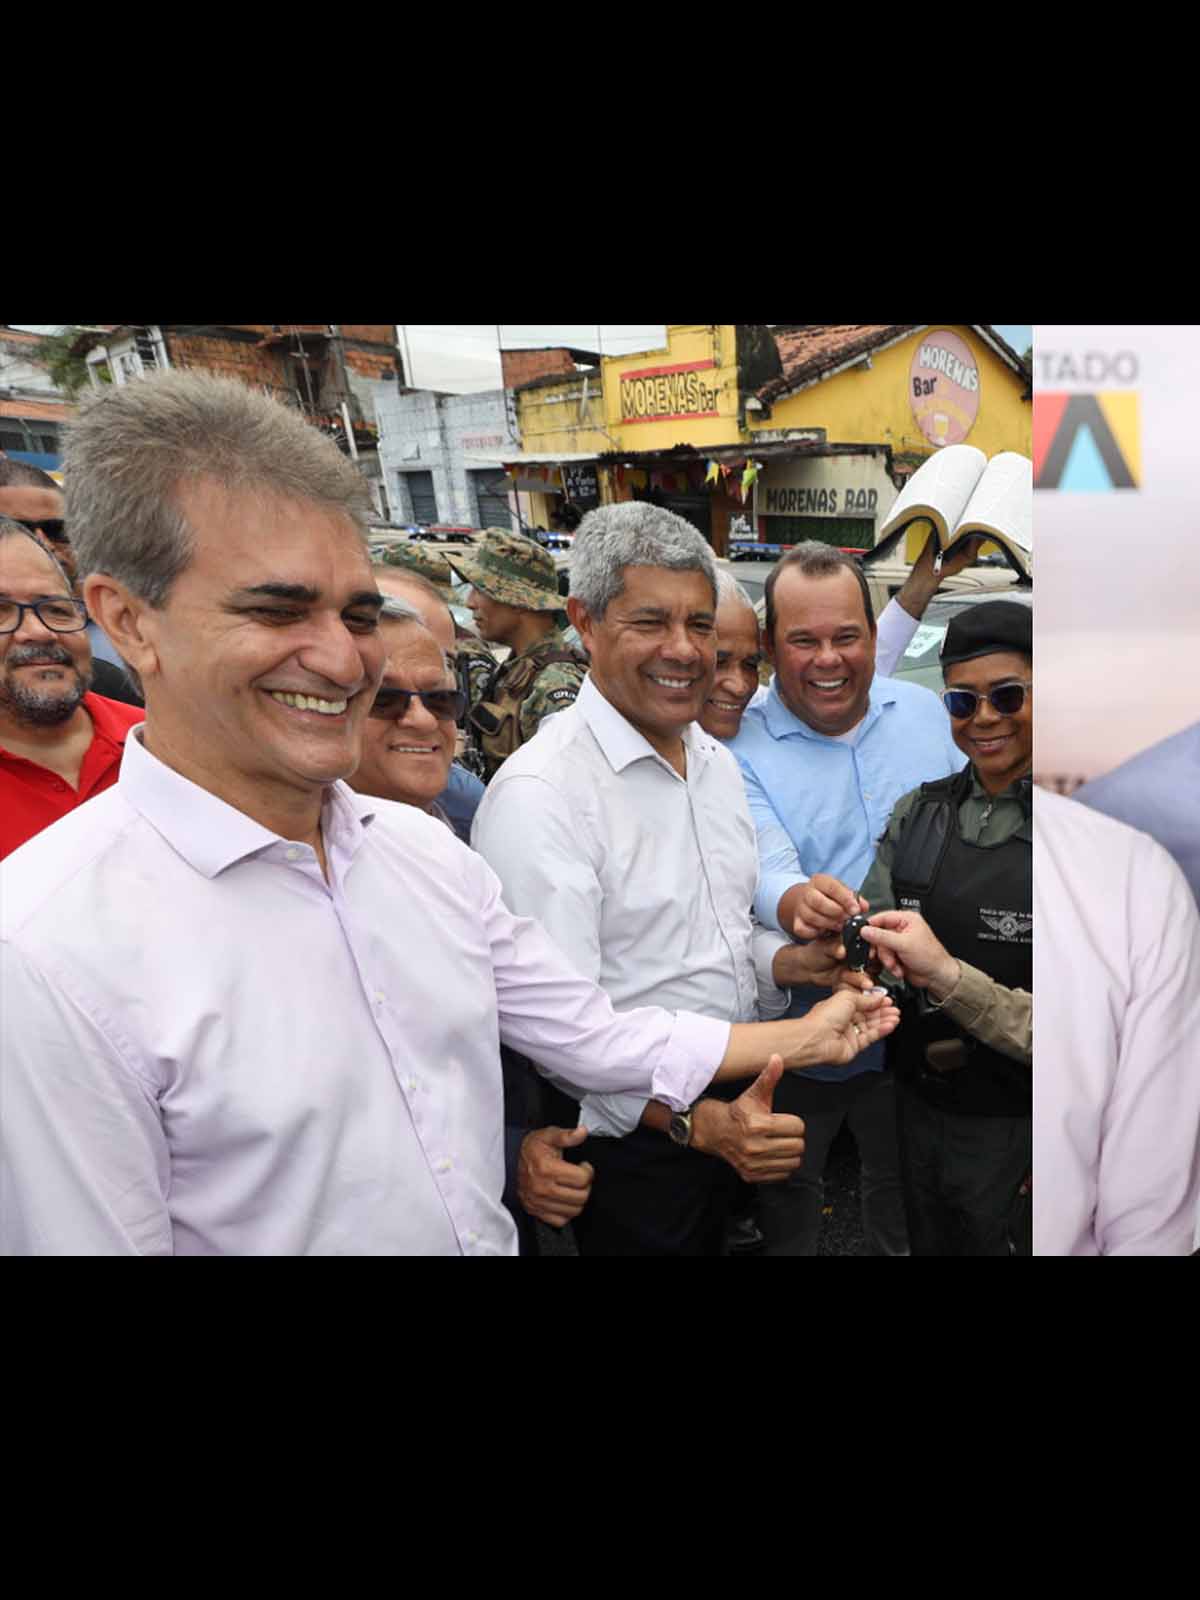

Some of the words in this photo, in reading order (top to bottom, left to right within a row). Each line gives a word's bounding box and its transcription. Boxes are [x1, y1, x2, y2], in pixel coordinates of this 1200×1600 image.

[919, 345, 978, 392] MORENAS
[1037, 350, 1140, 384] TADO
[620, 371, 699, 419] MORENAS
[700, 381, 720, 411] Bar
[913, 376, 937, 397] Bar
[767, 488, 837, 513] MORENAS
[845, 488, 878, 512] BAR
